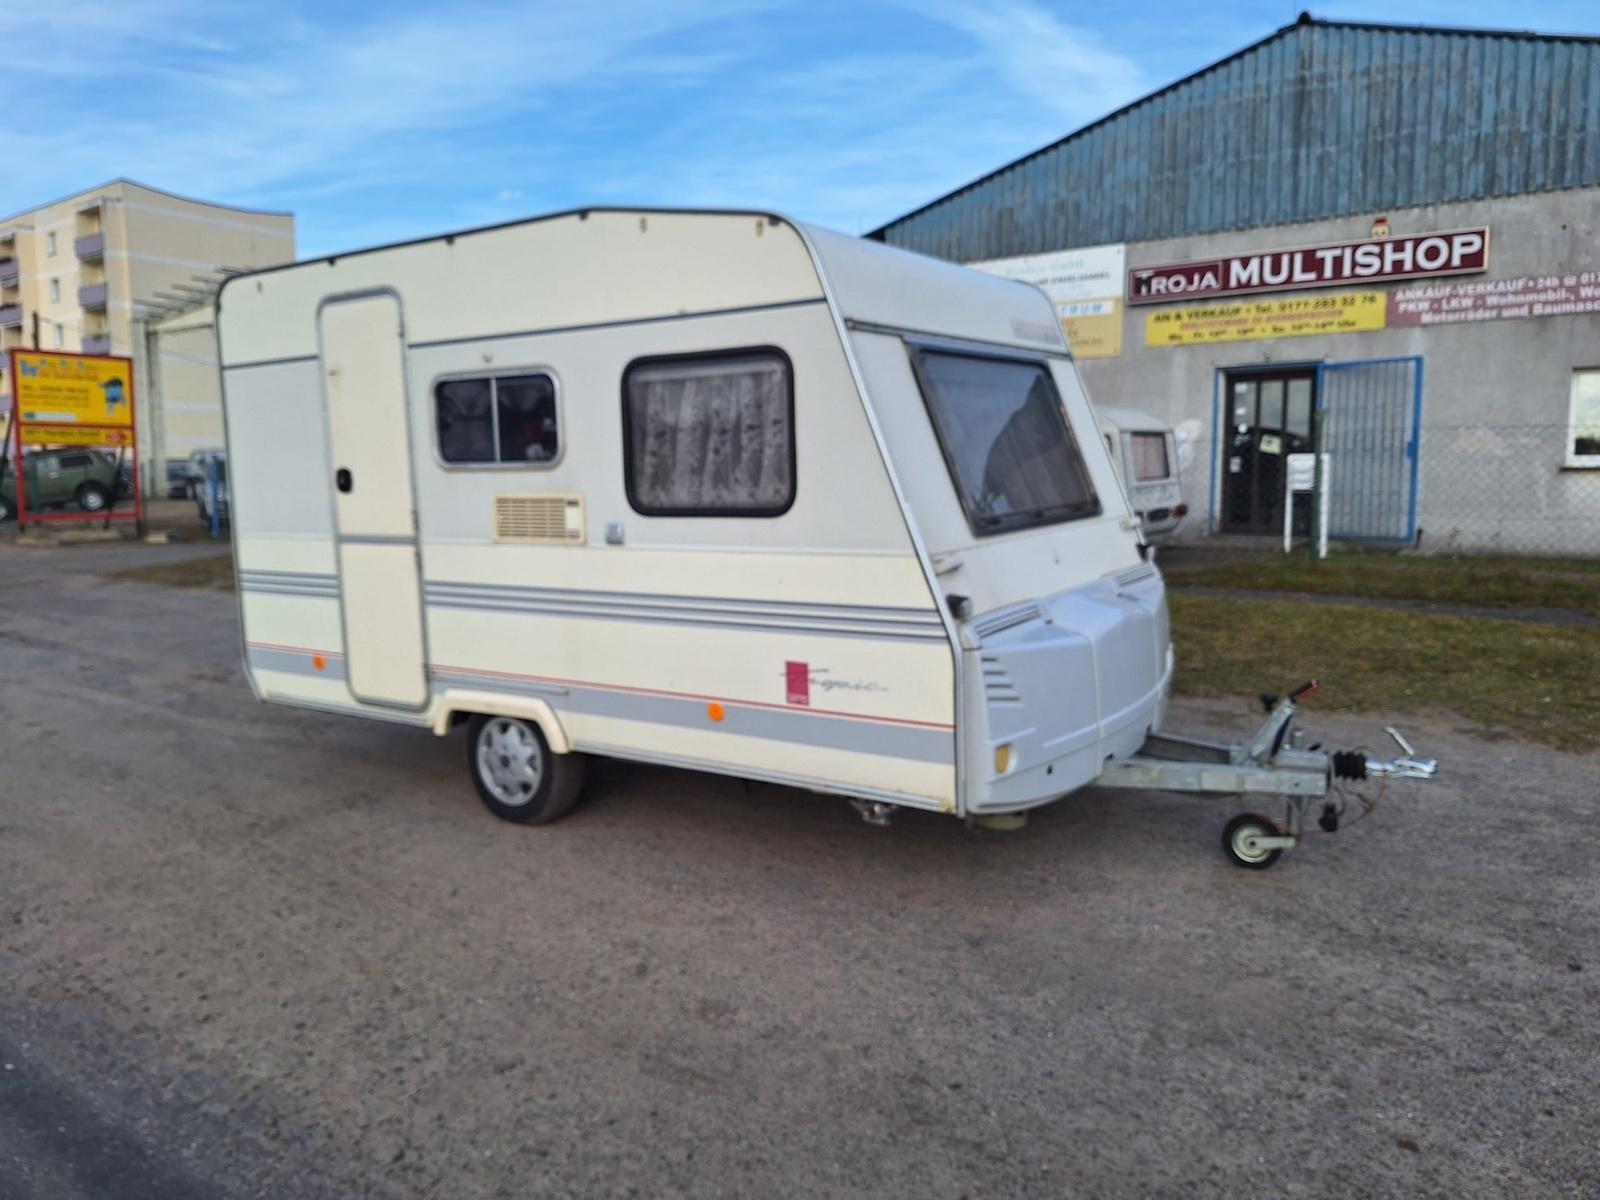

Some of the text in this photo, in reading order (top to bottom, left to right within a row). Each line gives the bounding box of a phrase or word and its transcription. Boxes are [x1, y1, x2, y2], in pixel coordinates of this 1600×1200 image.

[1228, 233, 1483, 289] MULTISHOP
[1399, 301, 1431, 314] PKW
[1441, 296, 1475, 310] LKW
